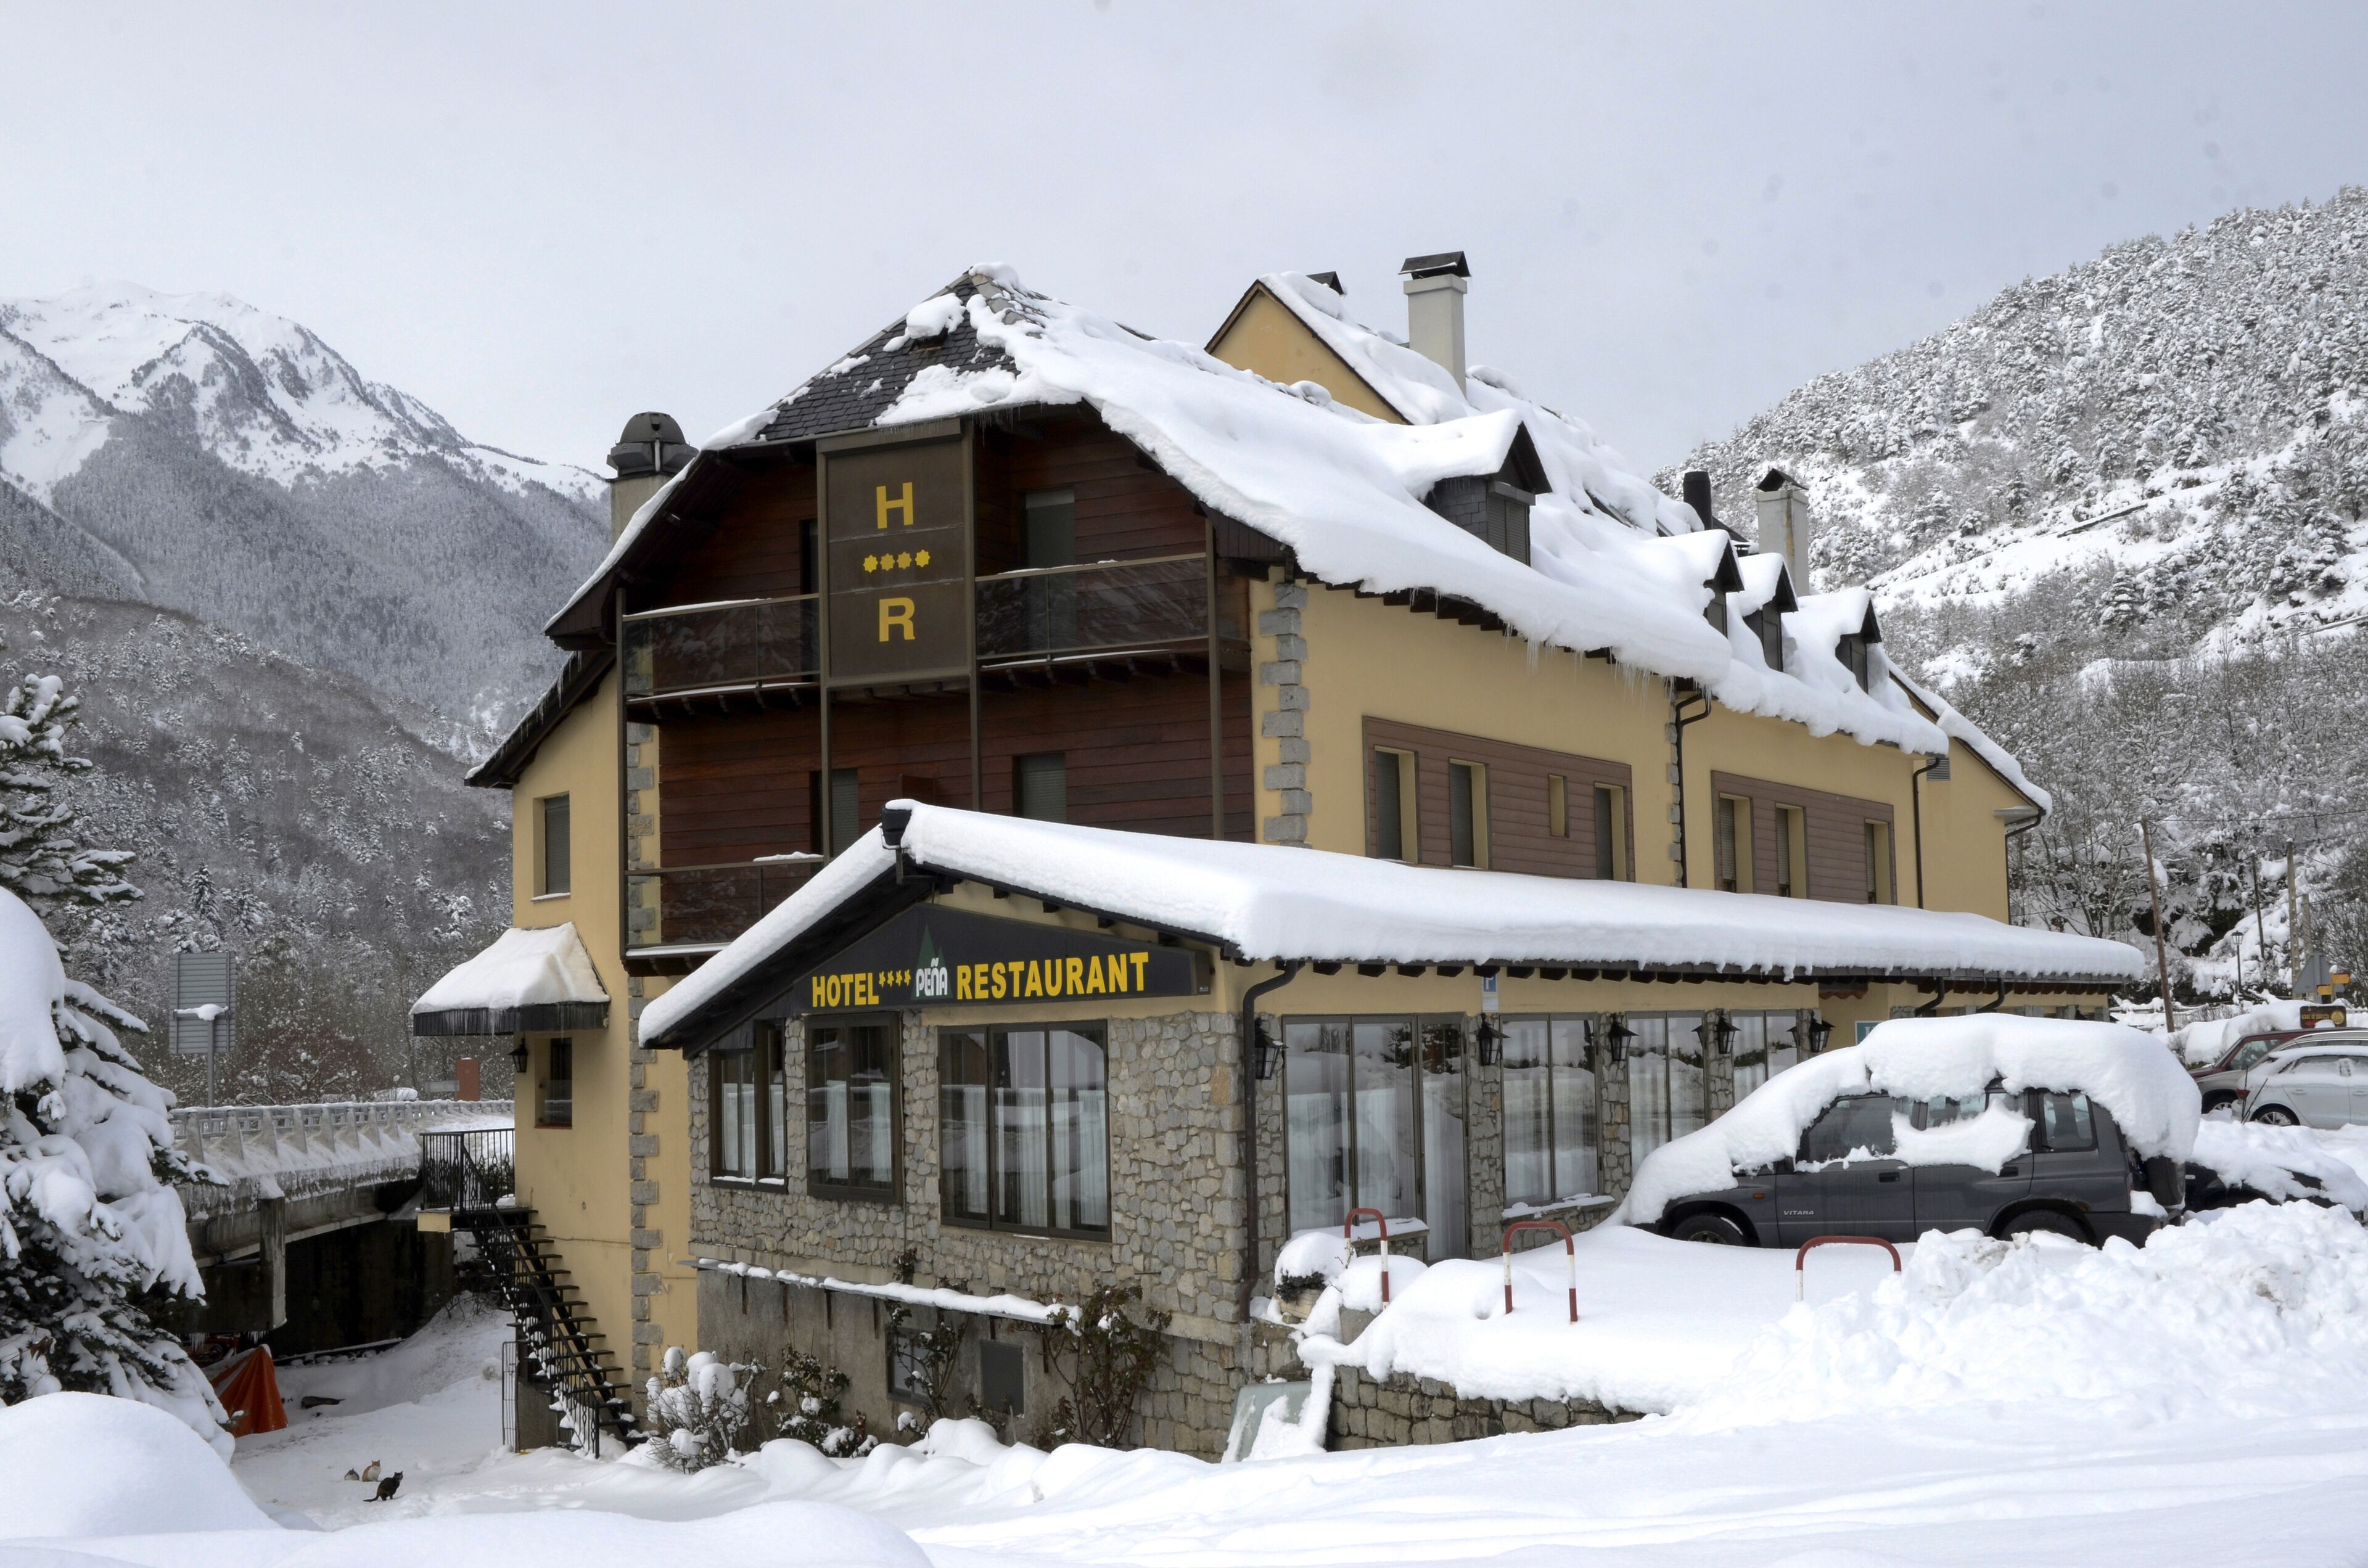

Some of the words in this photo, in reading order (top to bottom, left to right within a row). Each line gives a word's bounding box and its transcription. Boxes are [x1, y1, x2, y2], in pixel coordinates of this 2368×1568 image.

[876, 482, 914, 530] H
[879, 596, 916, 642] R
[812, 972, 880, 1008] HOTEL
[956, 951, 1149, 1000] RESTAURANT
